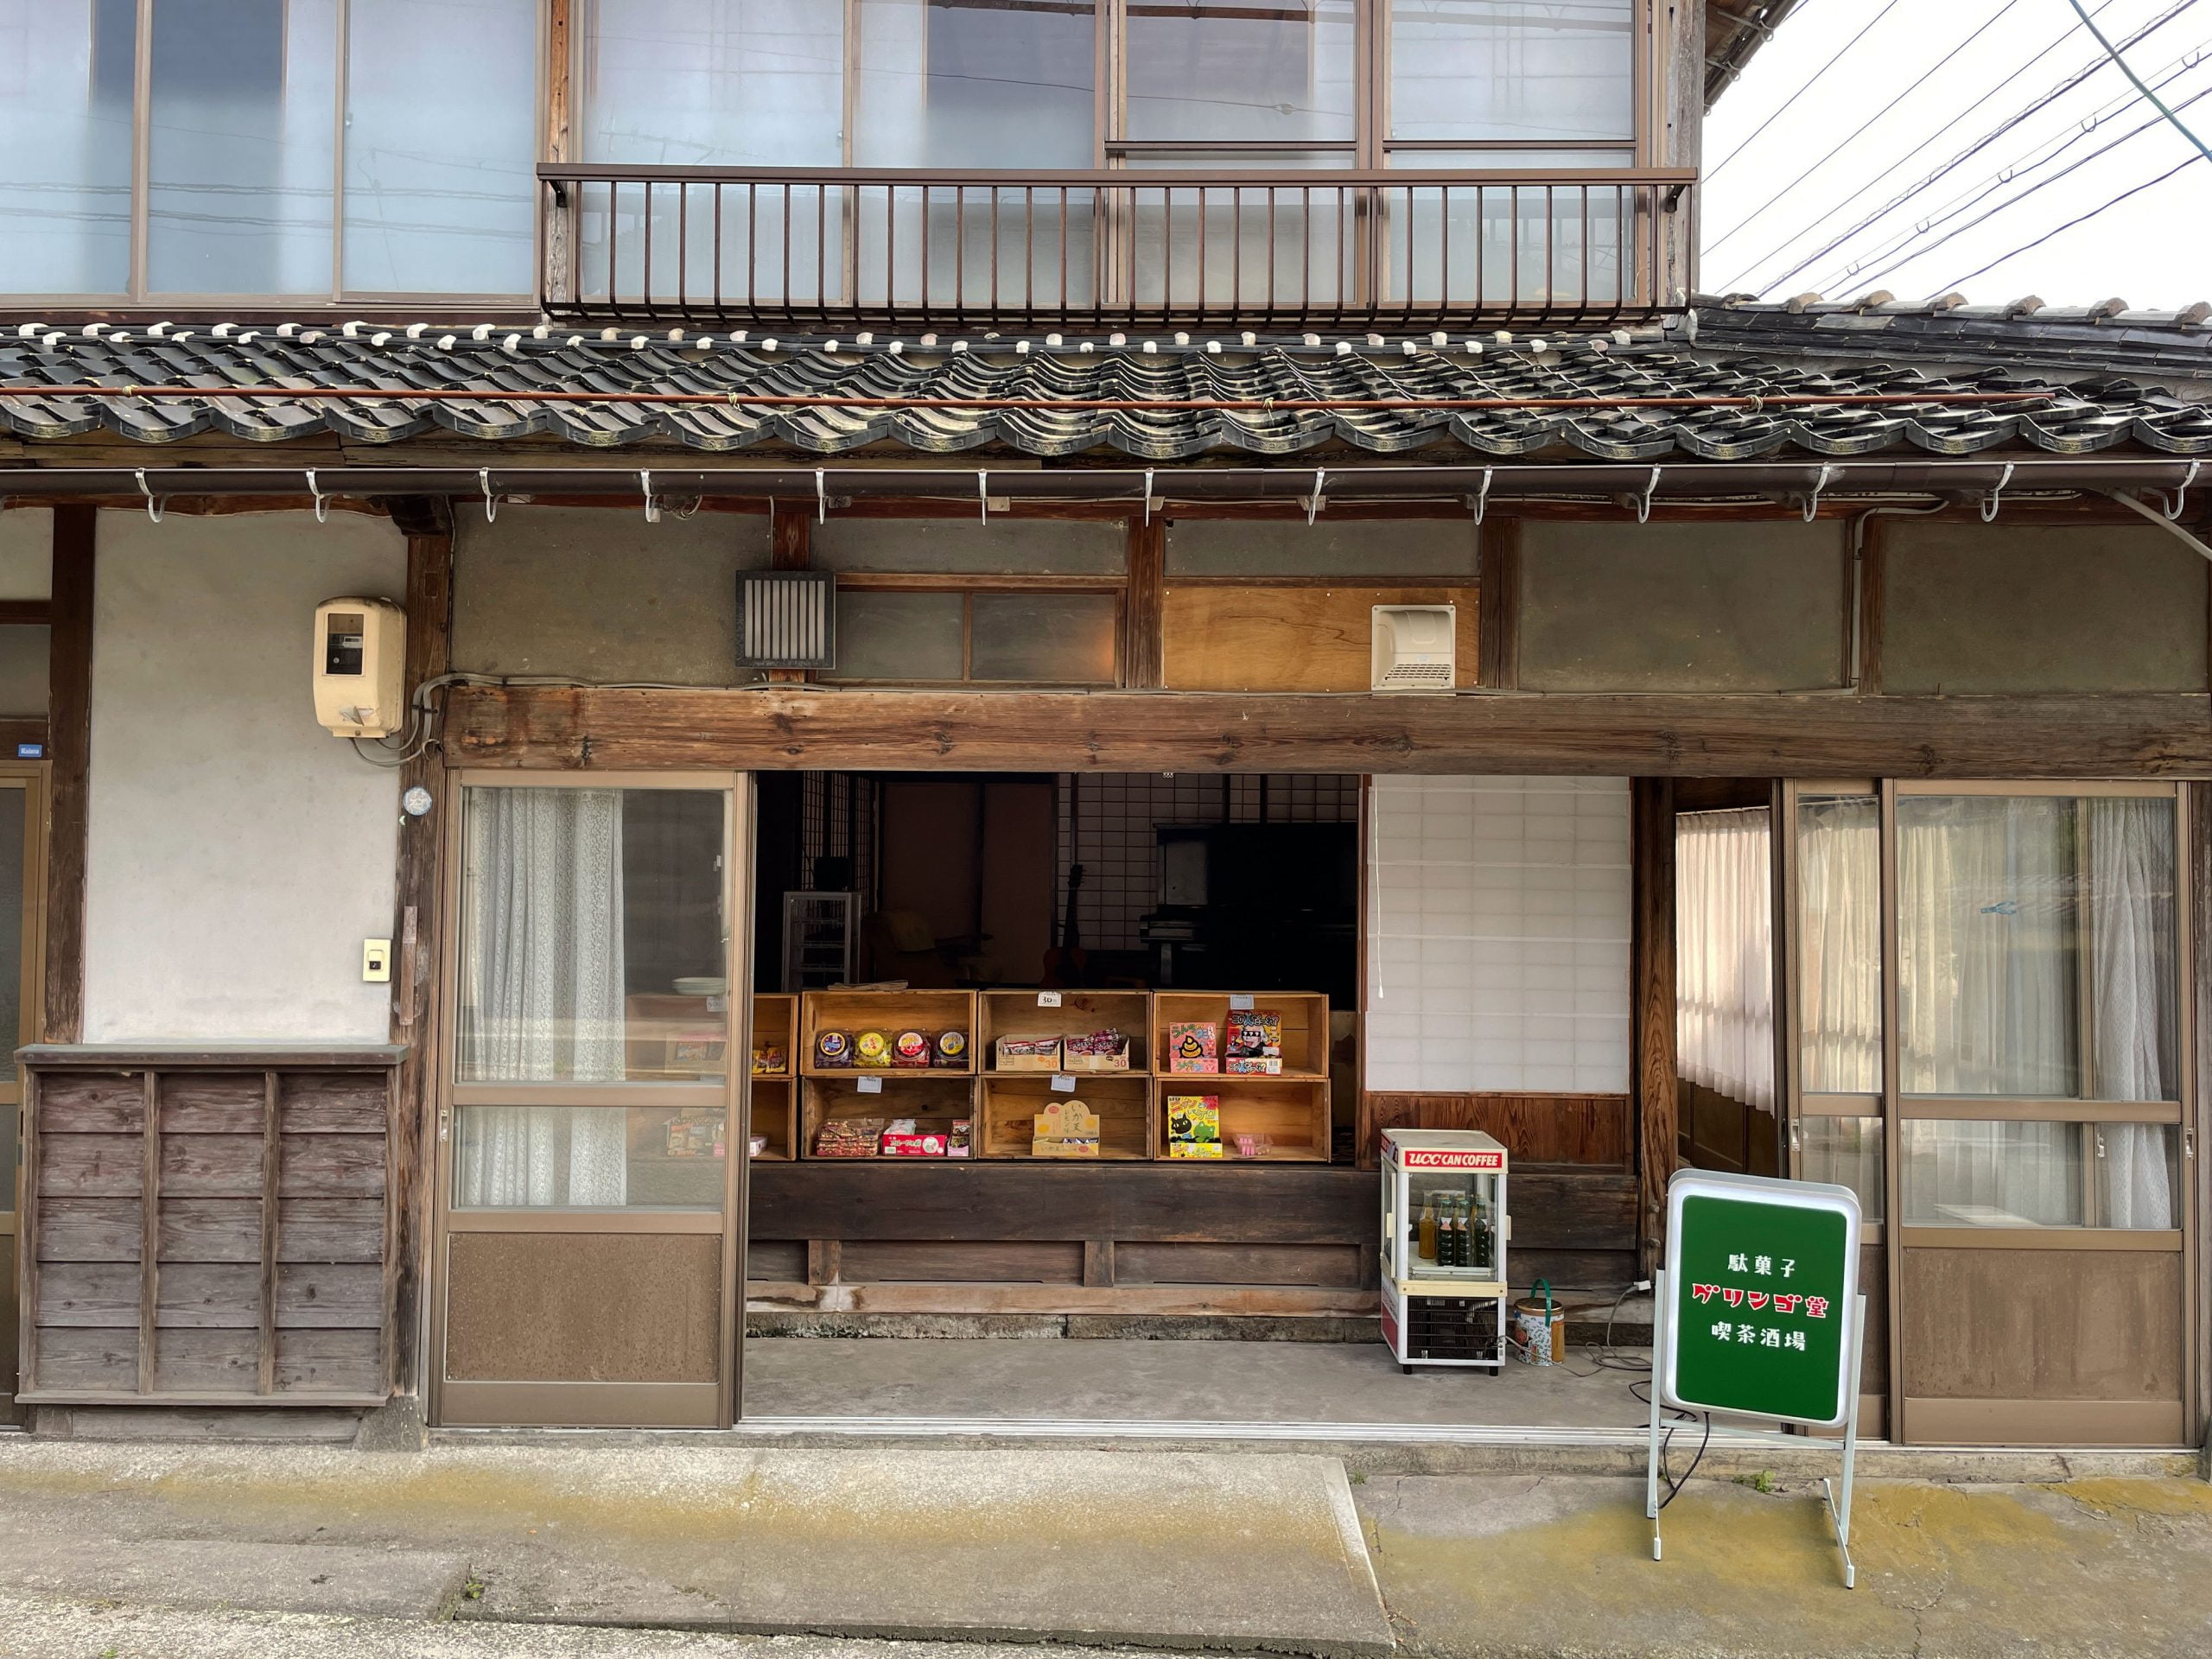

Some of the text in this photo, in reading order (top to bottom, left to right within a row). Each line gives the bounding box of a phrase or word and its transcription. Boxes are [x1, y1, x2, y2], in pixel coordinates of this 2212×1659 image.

[1045, 1059, 1058, 1069] 30
[1114, 1058, 1127, 1068] 30
[1408, 1153, 1498, 1166] UCC CAN COFFEE
[1728, 1253, 1796, 1278] 駄菓子
[1692, 1283, 1829, 1318] グリンゴ堂
[1711, 1321, 1806, 1351] 喫茶酒場
